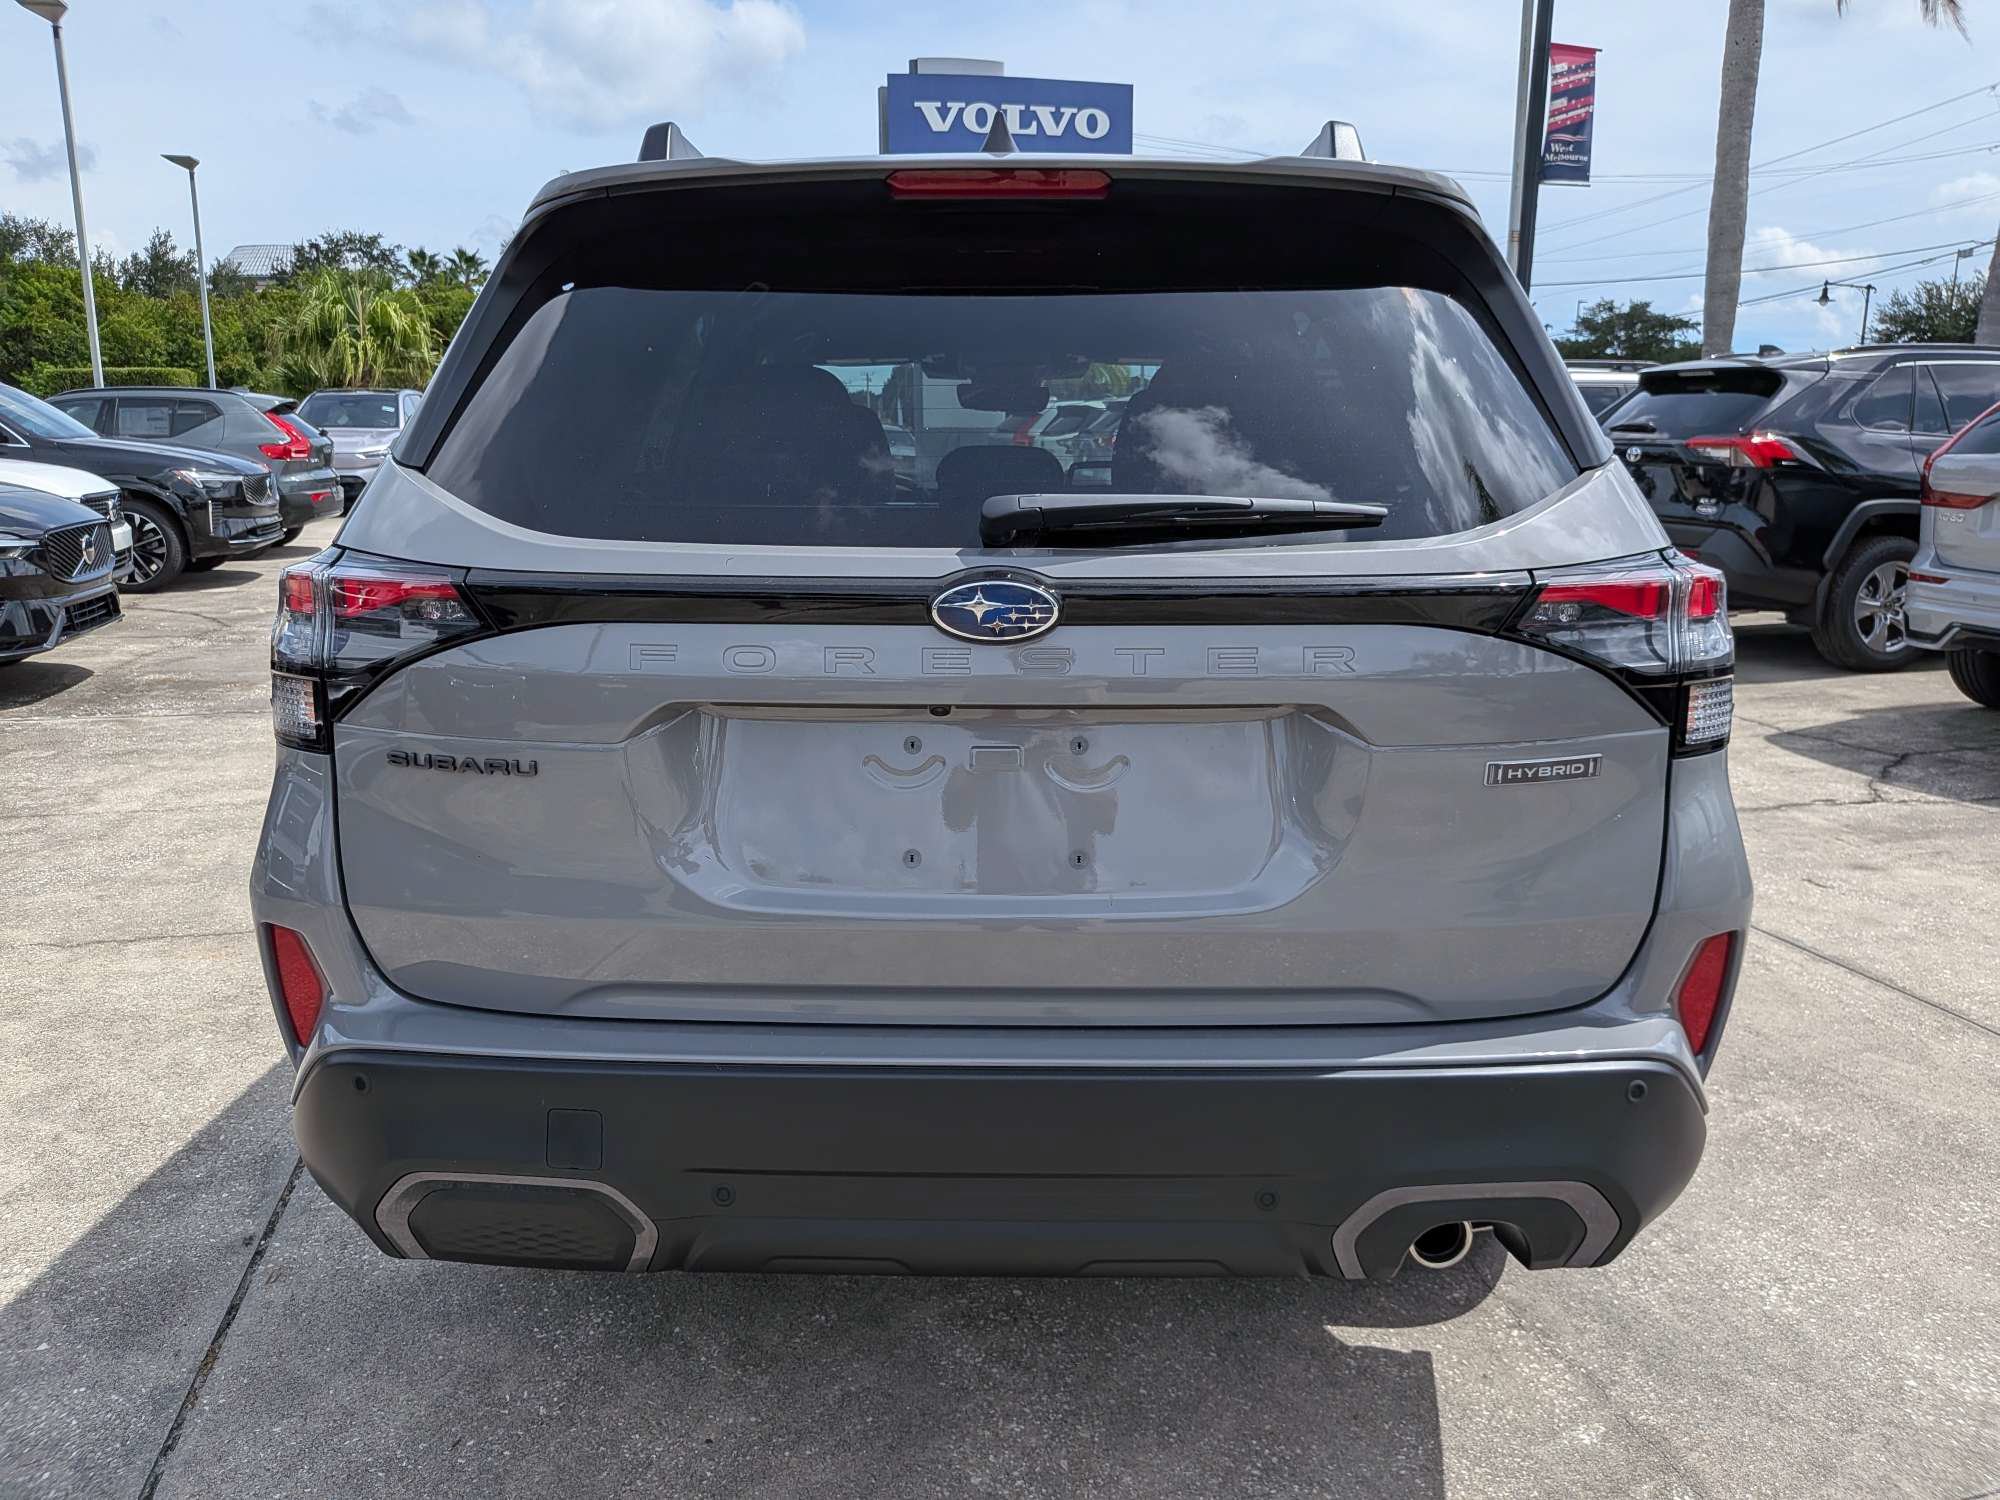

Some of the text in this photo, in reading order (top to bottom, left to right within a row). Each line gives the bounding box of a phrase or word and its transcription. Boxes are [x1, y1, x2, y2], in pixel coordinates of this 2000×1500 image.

[914, 101, 1110, 139] VOLVO
[629, 643, 1358, 675] FORESTER
[386, 750, 538, 777] SUBARU
[1507, 763, 1585, 779] HYBRID
